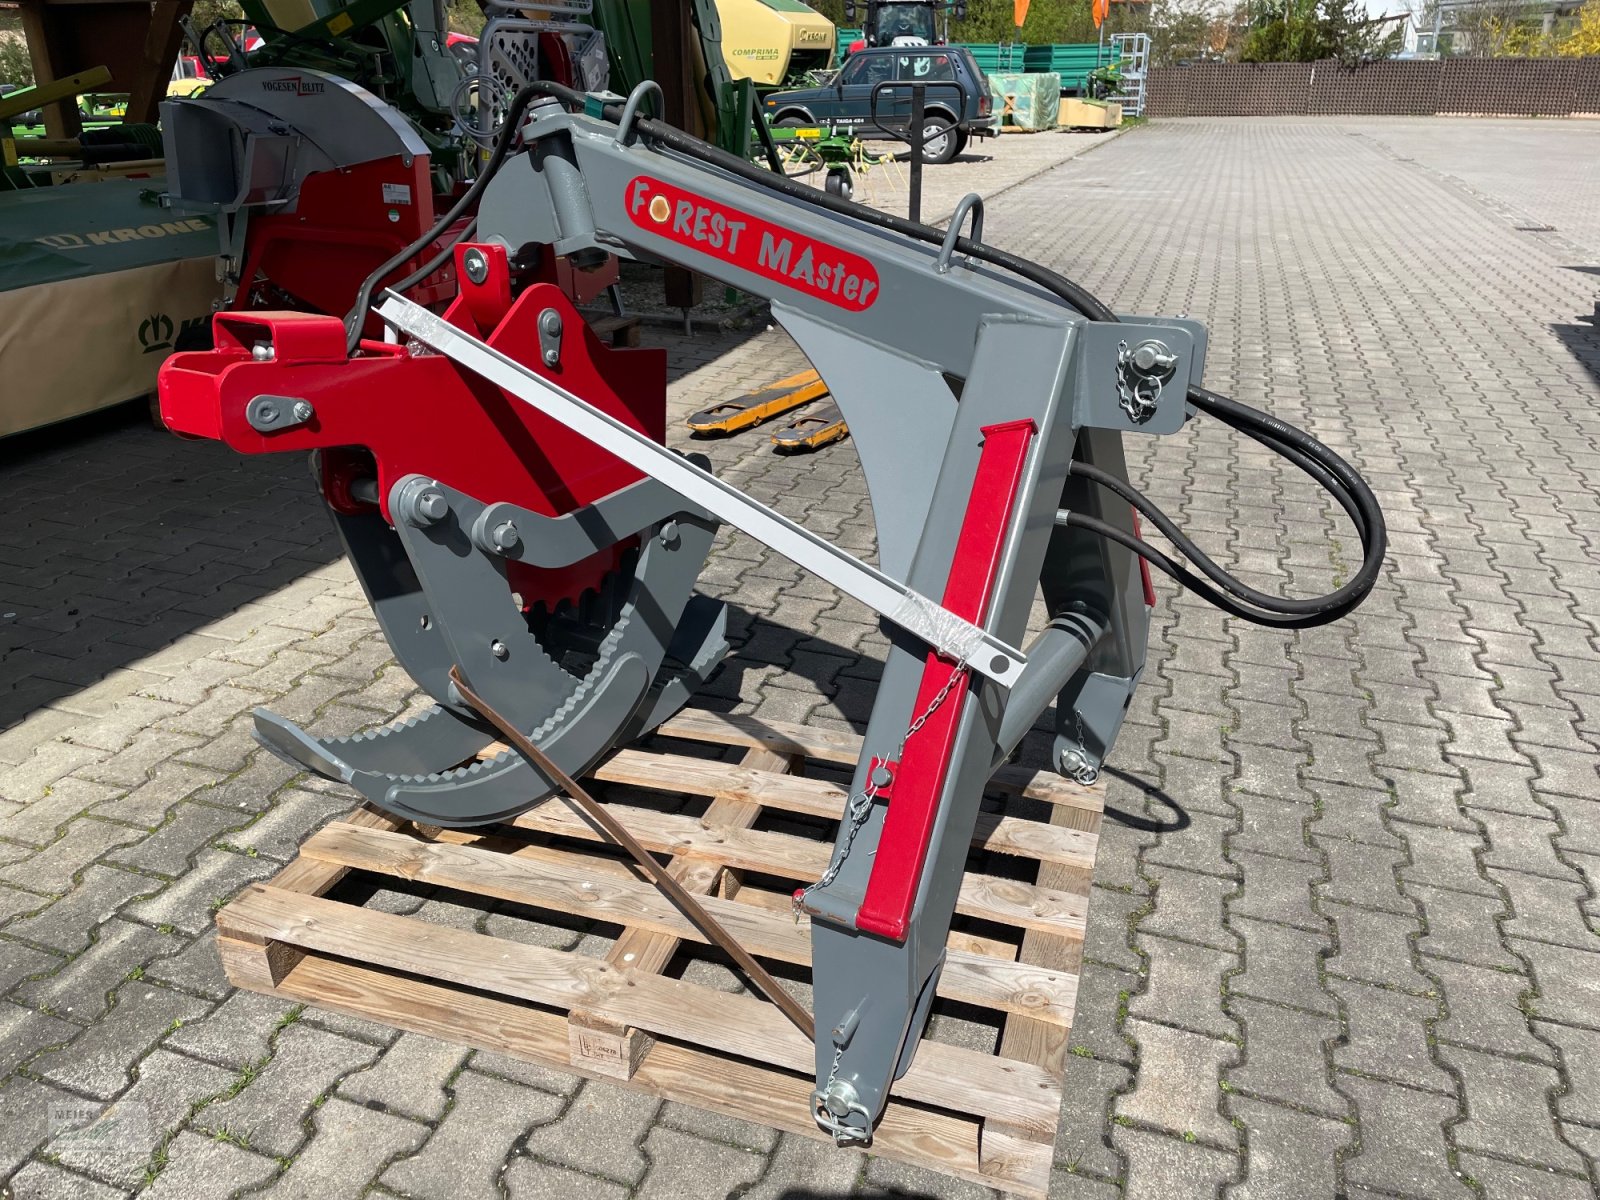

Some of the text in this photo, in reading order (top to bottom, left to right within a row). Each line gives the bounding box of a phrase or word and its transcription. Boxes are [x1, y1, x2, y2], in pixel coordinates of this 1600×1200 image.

[732, 48, 779, 56] COMPRIMA
[262, 80, 325, 93] VOGESEN BLITZ
[631, 180, 746, 255] FOREST
[85, 218, 211, 246] KRONE
